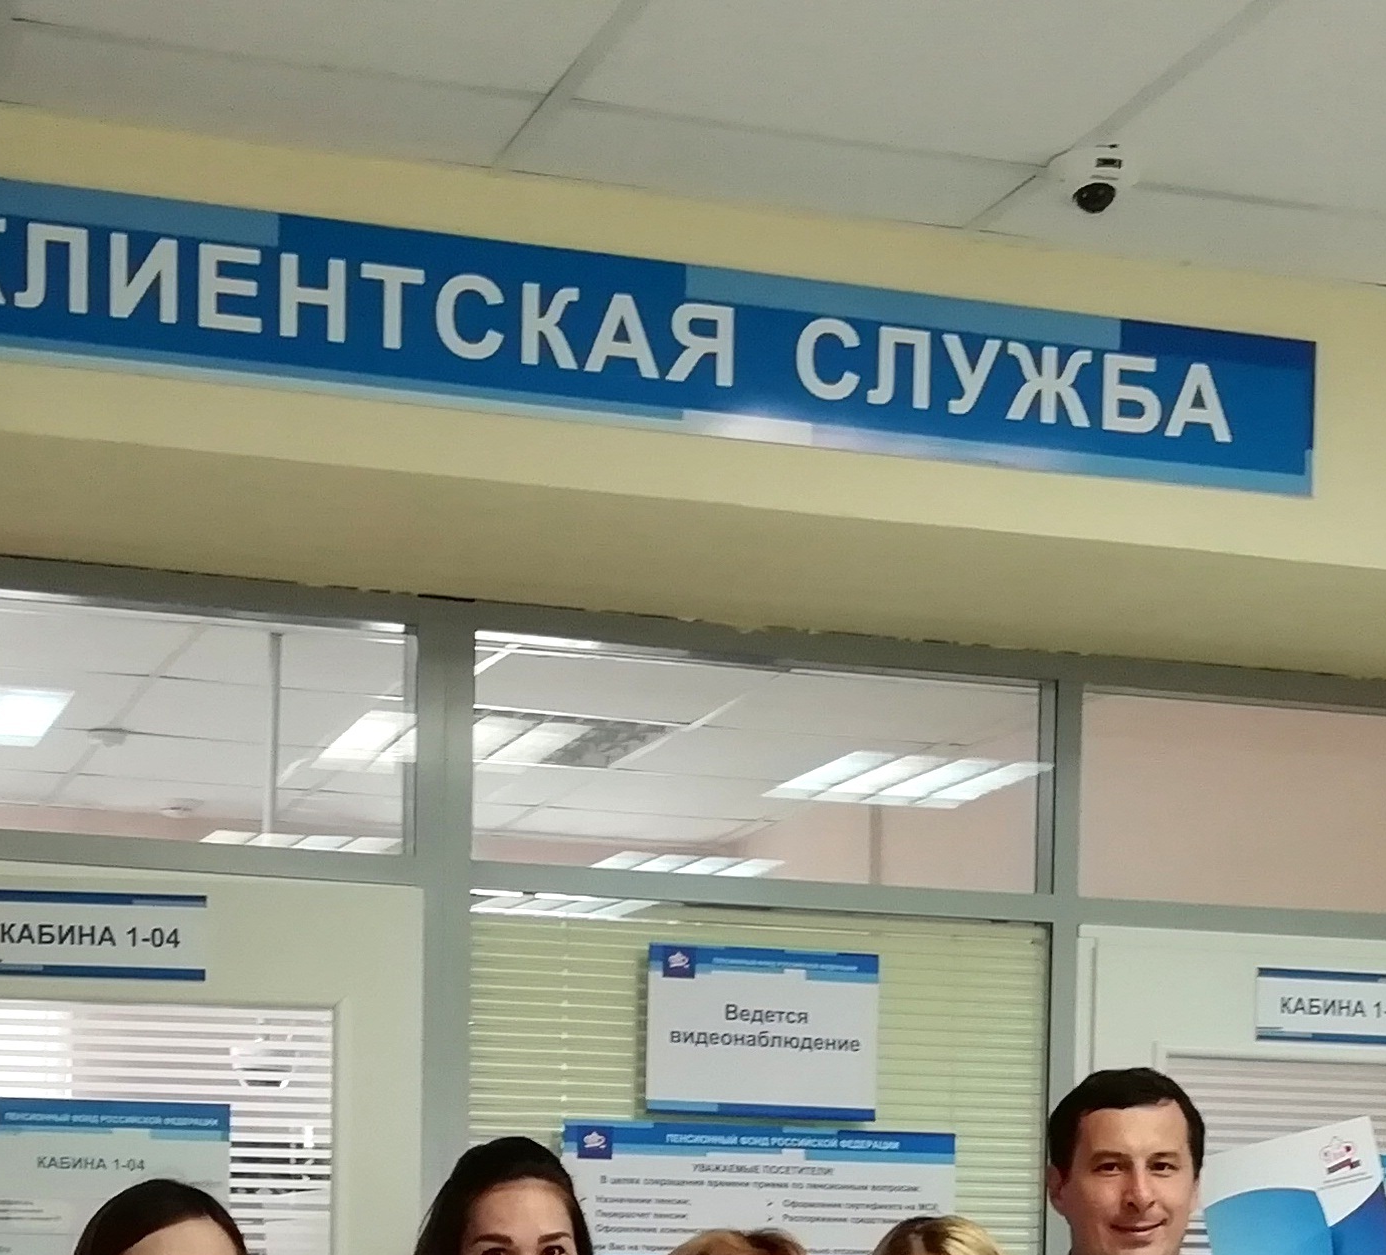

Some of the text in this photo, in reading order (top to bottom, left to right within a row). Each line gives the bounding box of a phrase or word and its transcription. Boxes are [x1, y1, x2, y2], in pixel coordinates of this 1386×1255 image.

[795, 316, 1233, 444] СЛУЖБА
[0, 922, 181, 949] КАБИНА 1-04
[725, 1003, 809, 1024] Ведется
[1280, 995, 1366, 1018] КАБИНА
[669, 1028, 861, 1052] видеонаблюдение
[36, 1156, 145, 1172] КАБИНА 1-04
